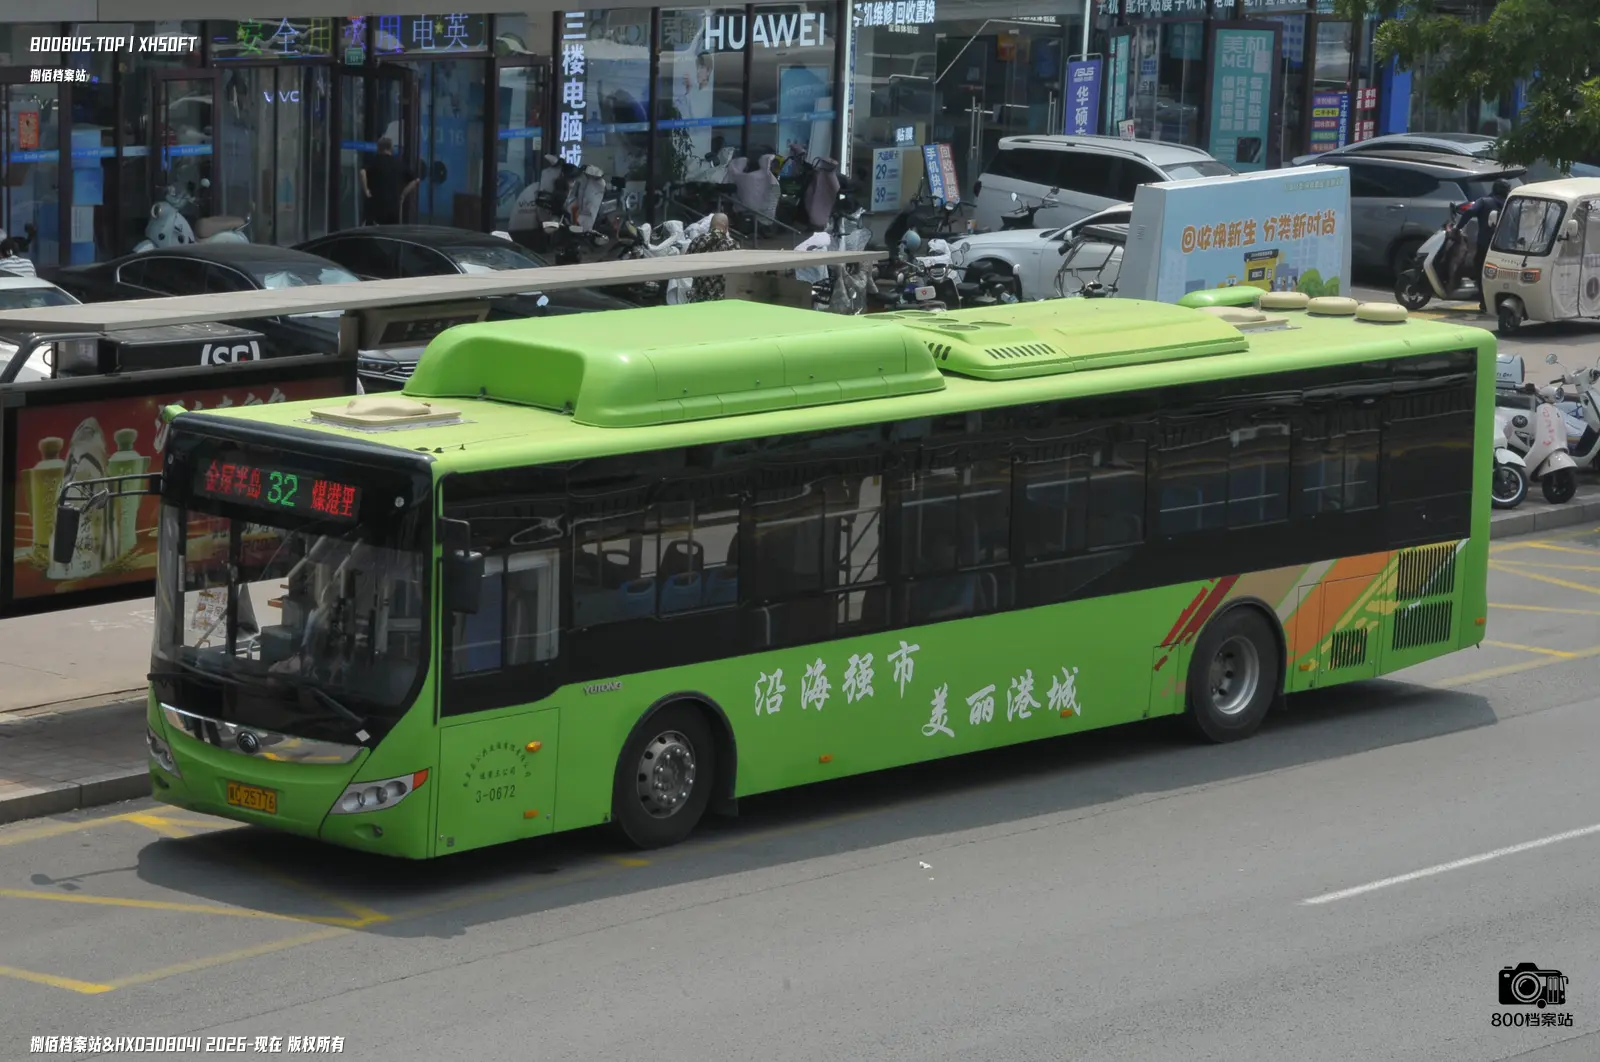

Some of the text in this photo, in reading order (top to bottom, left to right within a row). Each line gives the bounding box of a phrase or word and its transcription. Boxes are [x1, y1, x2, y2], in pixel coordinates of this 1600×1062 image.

[705, 13, 825, 50] HUAWEI
[559, 12, 586, 168] 三楼电脑城
[876, 164, 887, 180] 29
[875, 187, 886, 204] 39
[1263, 209, 1336, 242] 分类新时尚
[267, 471, 298, 507] 32
[583, 682, 622, 695] YUTONG
[754, 641, 920, 716] 沿海强市
[921, 666, 1082, 738] 美丽港城
[475, 784, 516, 804] 3-0672
